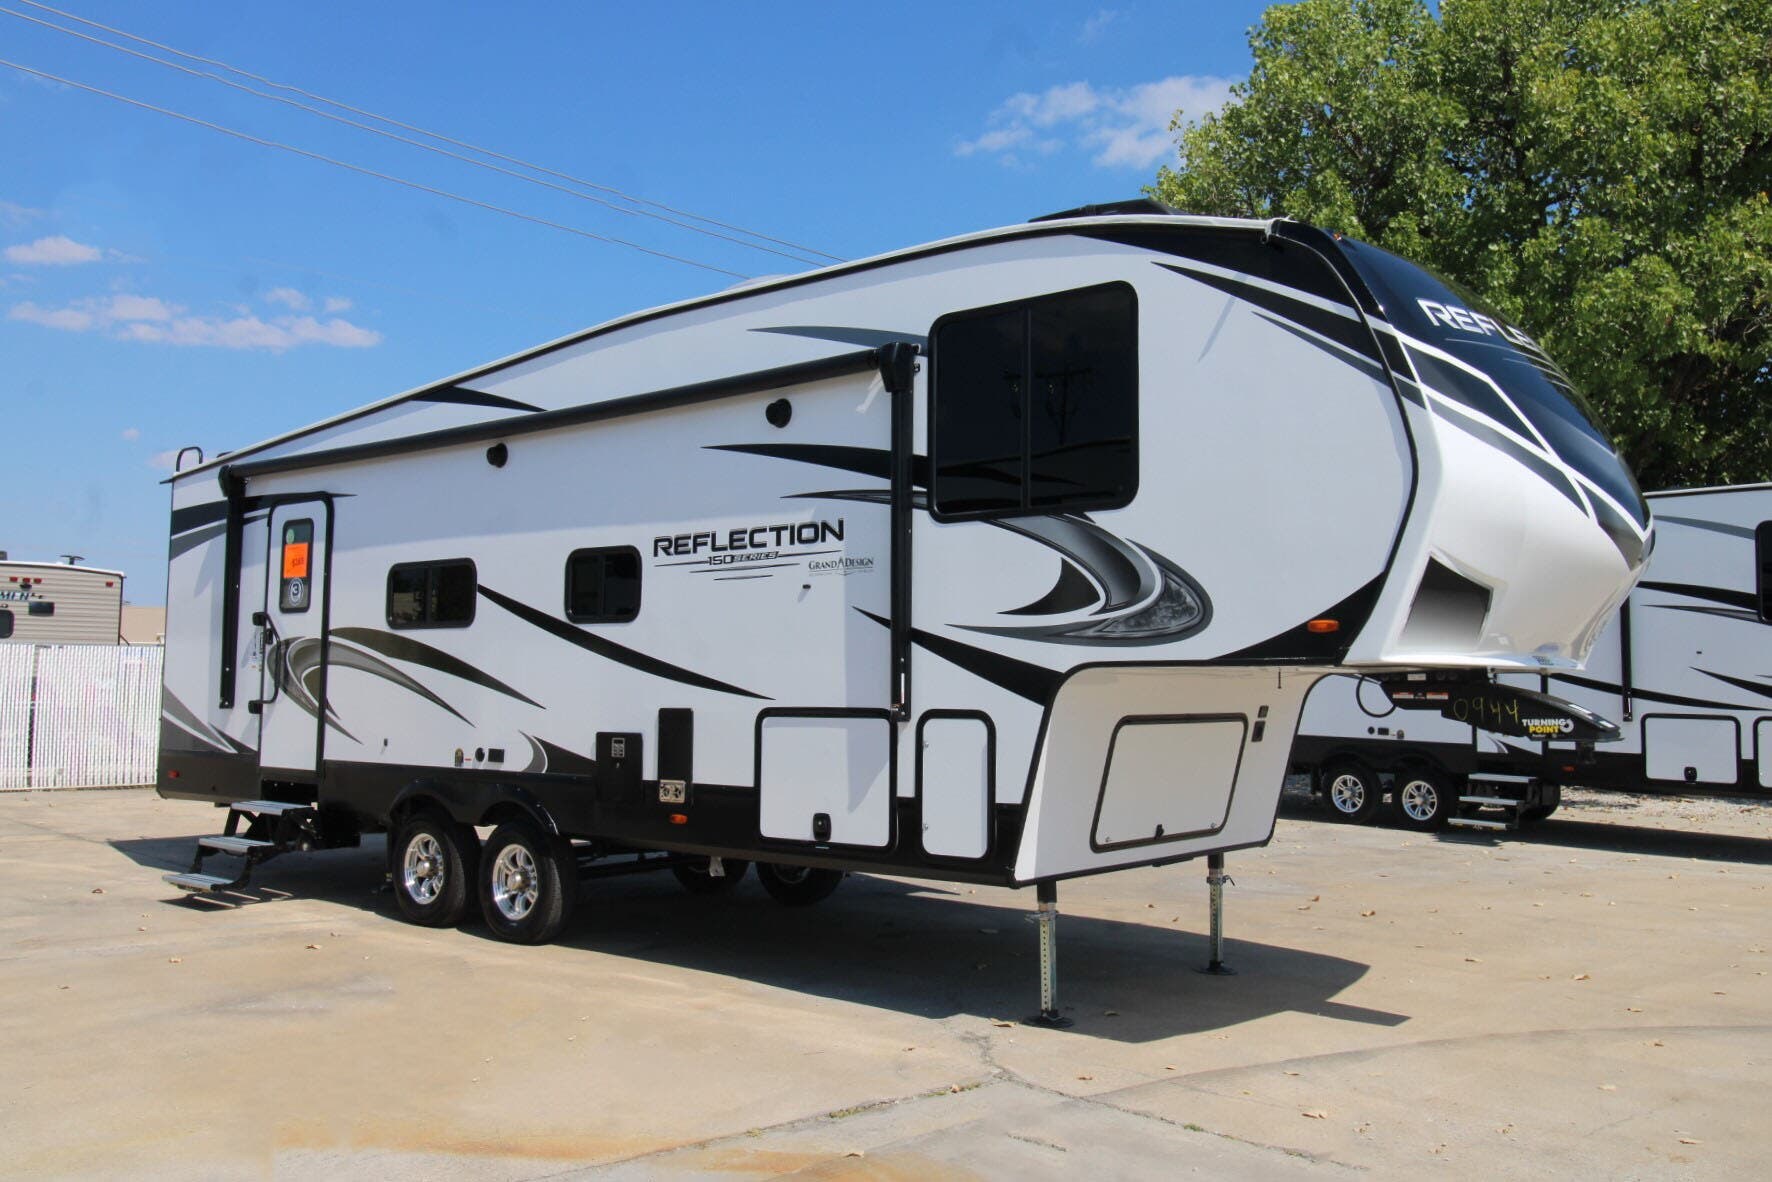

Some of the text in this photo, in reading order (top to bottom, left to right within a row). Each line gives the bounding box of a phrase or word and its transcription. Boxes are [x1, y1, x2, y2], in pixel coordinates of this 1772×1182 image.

[653, 518, 844, 557] REFLECTION
[1522, 719, 1567, 727] TURNING
[1529, 725, 1559, 734] POINT
